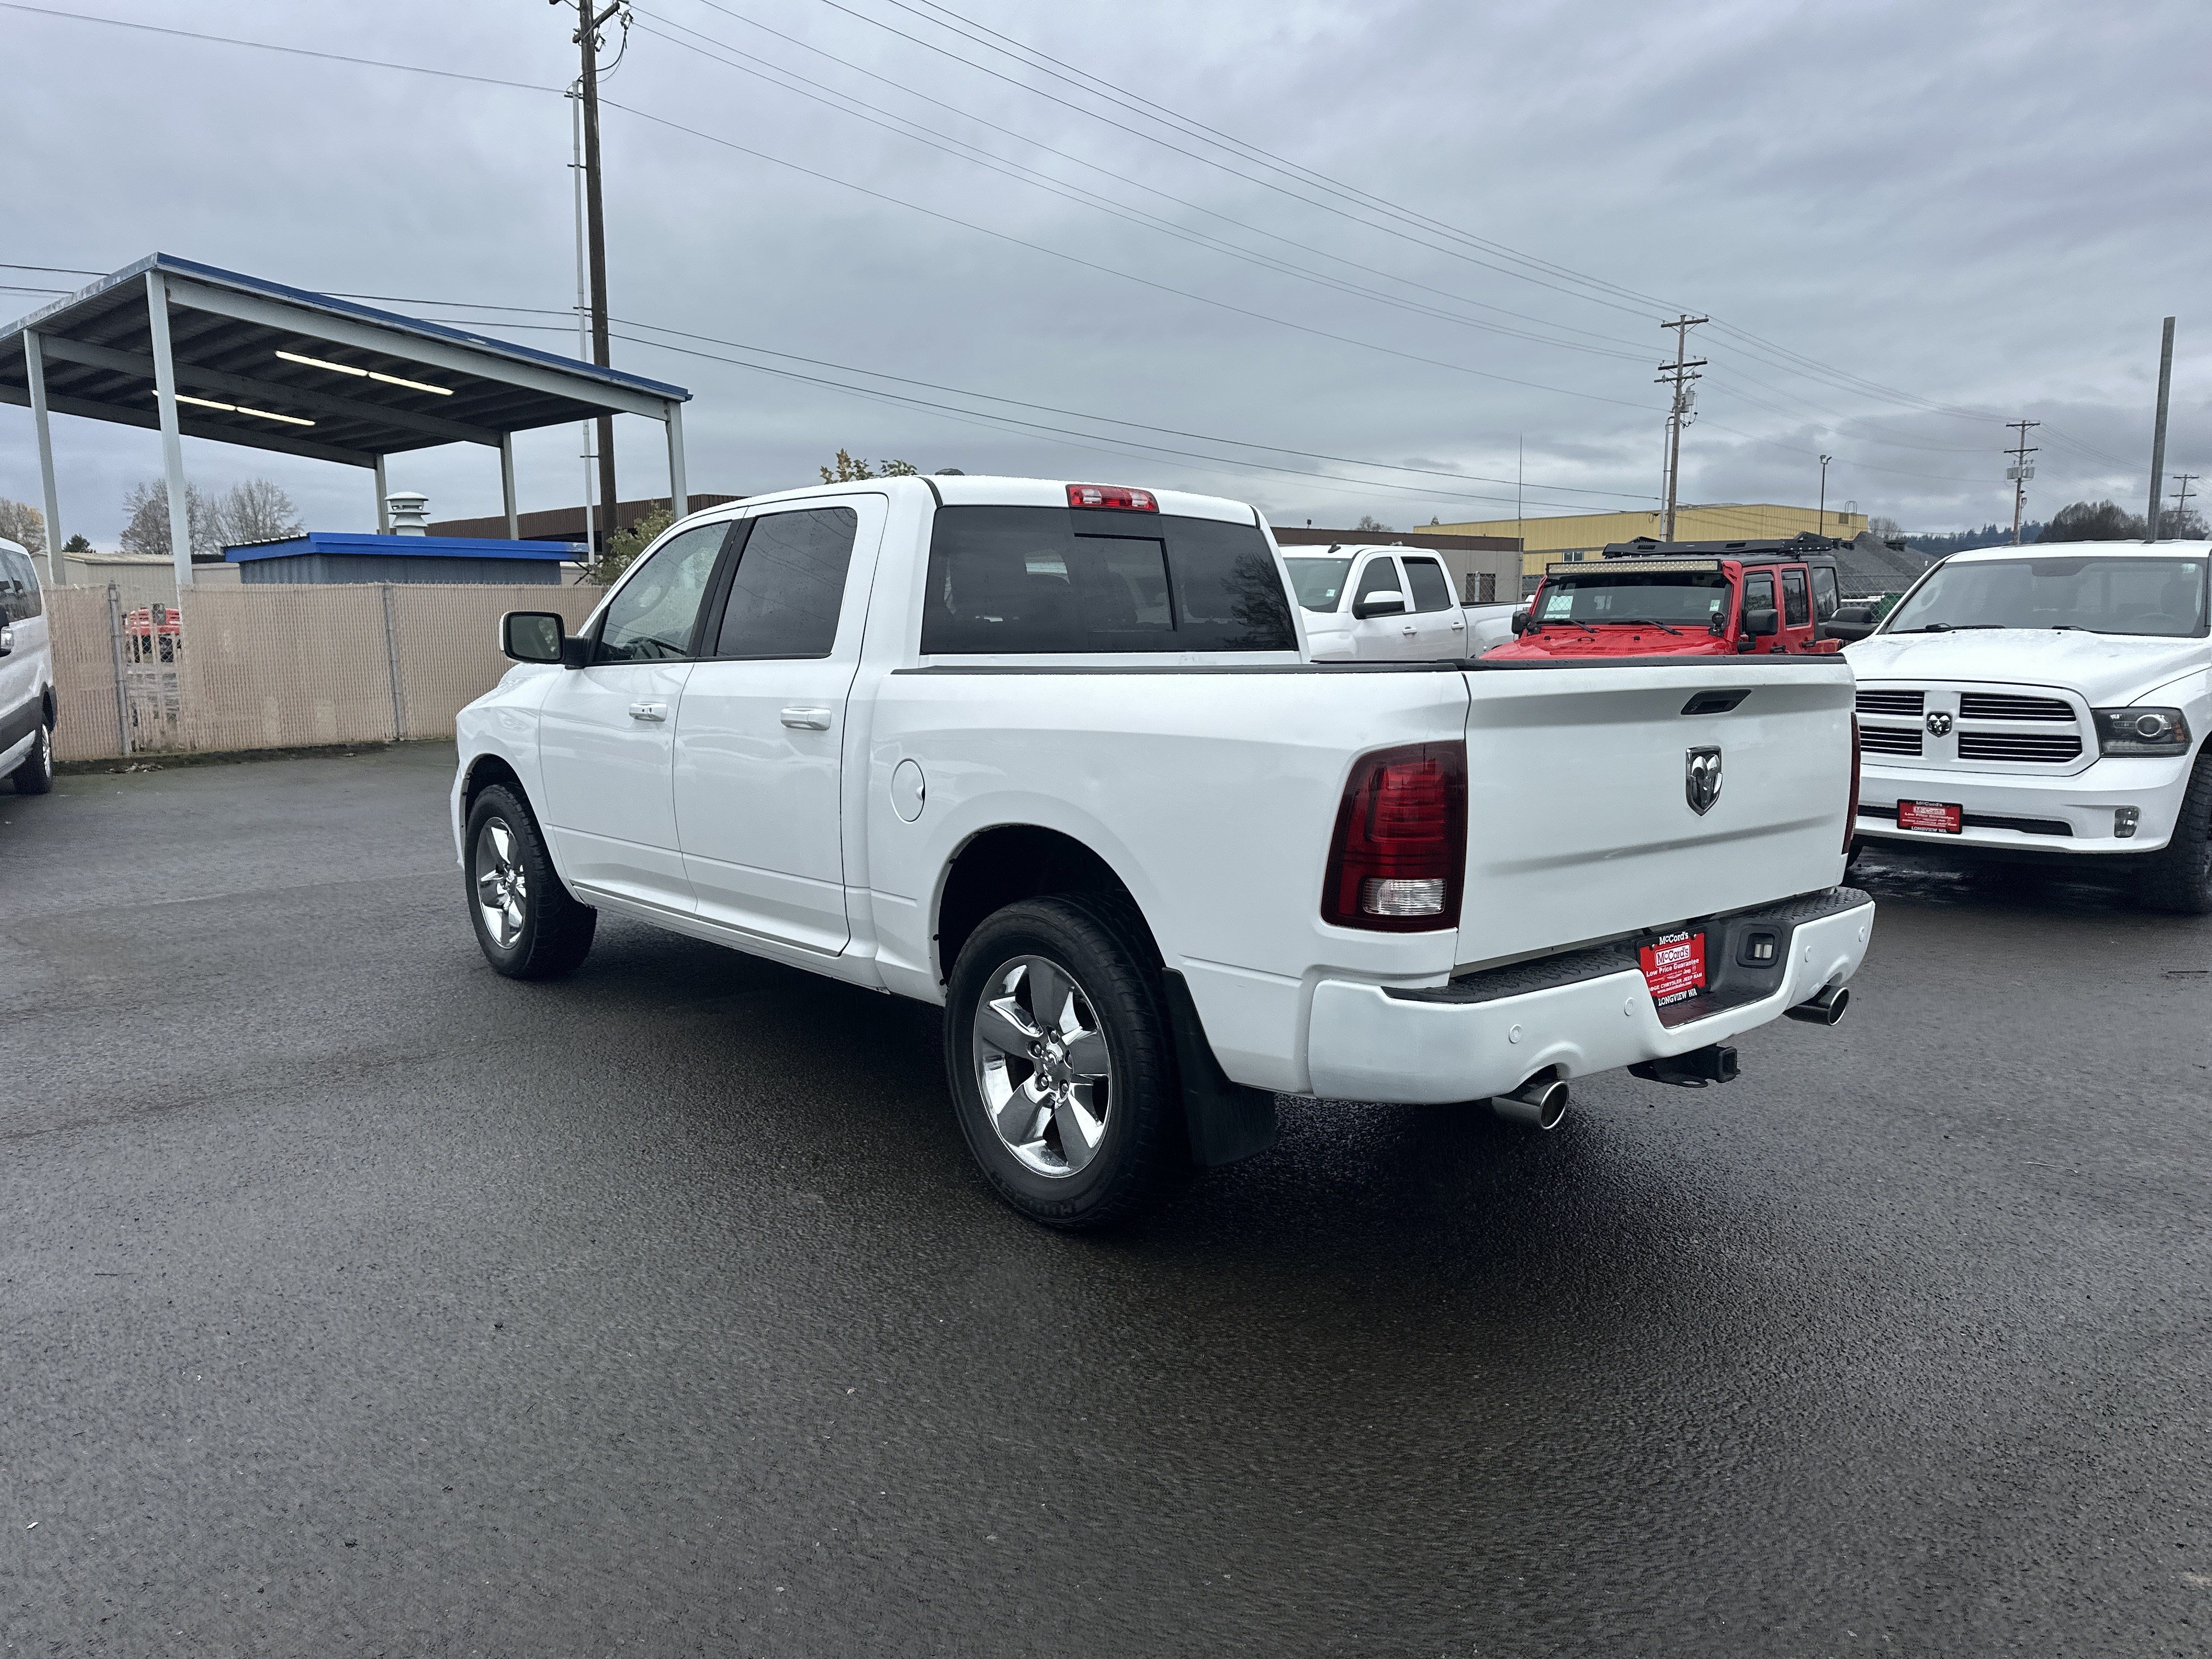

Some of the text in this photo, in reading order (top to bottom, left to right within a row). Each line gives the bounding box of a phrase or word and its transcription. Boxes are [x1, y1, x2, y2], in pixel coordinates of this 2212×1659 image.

[1659, 932, 1689, 945] McCord's
[1657, 947, 1689, 964] McCord's
[1658, 966, 1672, 974] Price
[1673, 959, 1700, 970] Guarantee
[1660, 978, 1682, 990] CHRYSLER
[1658, 988, 1697, 1006] LONGVIEW WA
